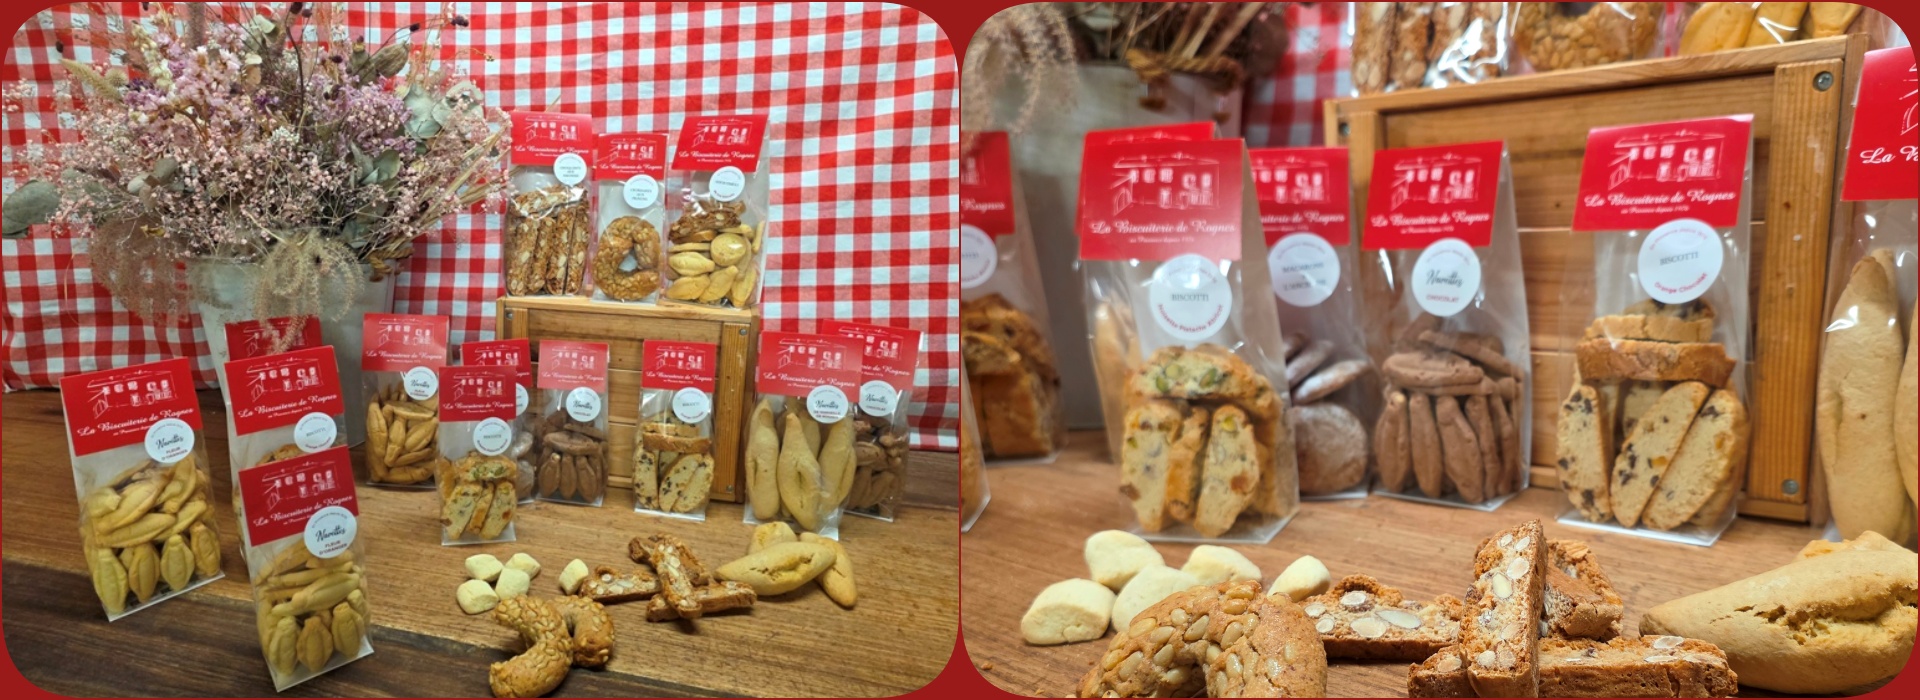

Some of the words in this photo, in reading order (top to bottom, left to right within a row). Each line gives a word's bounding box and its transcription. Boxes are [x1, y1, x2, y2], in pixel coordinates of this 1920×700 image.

[1860, 147, 1896, 164] La
[1584, 194, 1605, 207] La
[1608, 192, 1669, 206] Biscuiterie
[1670, 191, 1684, 204] de
[1686, 188, 1736, 205] Rognes
[1371, 214, 1388, 227] La
[1390, 213, 1438, 226] Biscuiterie
[1438, 213, 1450, 224] de
[1452, 210, 1490, 226] Rognes
[1090, 221, 1112, 234] La
[1114, 220, 1173, 234] Biscuiterie
[1176, 221, 1188, 232] de
[1192, 220, 1236, 235] Rognes
[1660, 251, 1699, 266] BISCOTTI
[1426, 270, 1463, 288] Navettes
[1654, 282, 1677, 294] Orange
[1679, 272, 1707, 293] Chocolat
[1426, 294, 1460, 303] CHOCOLAT
[763, 372, 776, 380] La
[778, 372, 816, 384] Biscuiterie
[817, 376, 826, 384] de
[827, 376, 856, 388] Rognes
[238, 408, 254, 418] La
[254, 402, 298, 414] Biscuiterie
[298, 398, 307, 406] de
[308, 394, 337, 404] Rognes
[816, 400, 838, 409] Navettes
[77, 427, 96, 436] La
[98, 417, 148, 432] Biscuiterie
[160, 407, 194, 418] Rognes
[156, 434, 184, 449] Navettes
[253, 517, 269, 527] La
[270, 507, 313, 521] Biscuiterie
[323, 495, 352, 506] Rognes
[316, 525, 346, 542] Navettes
